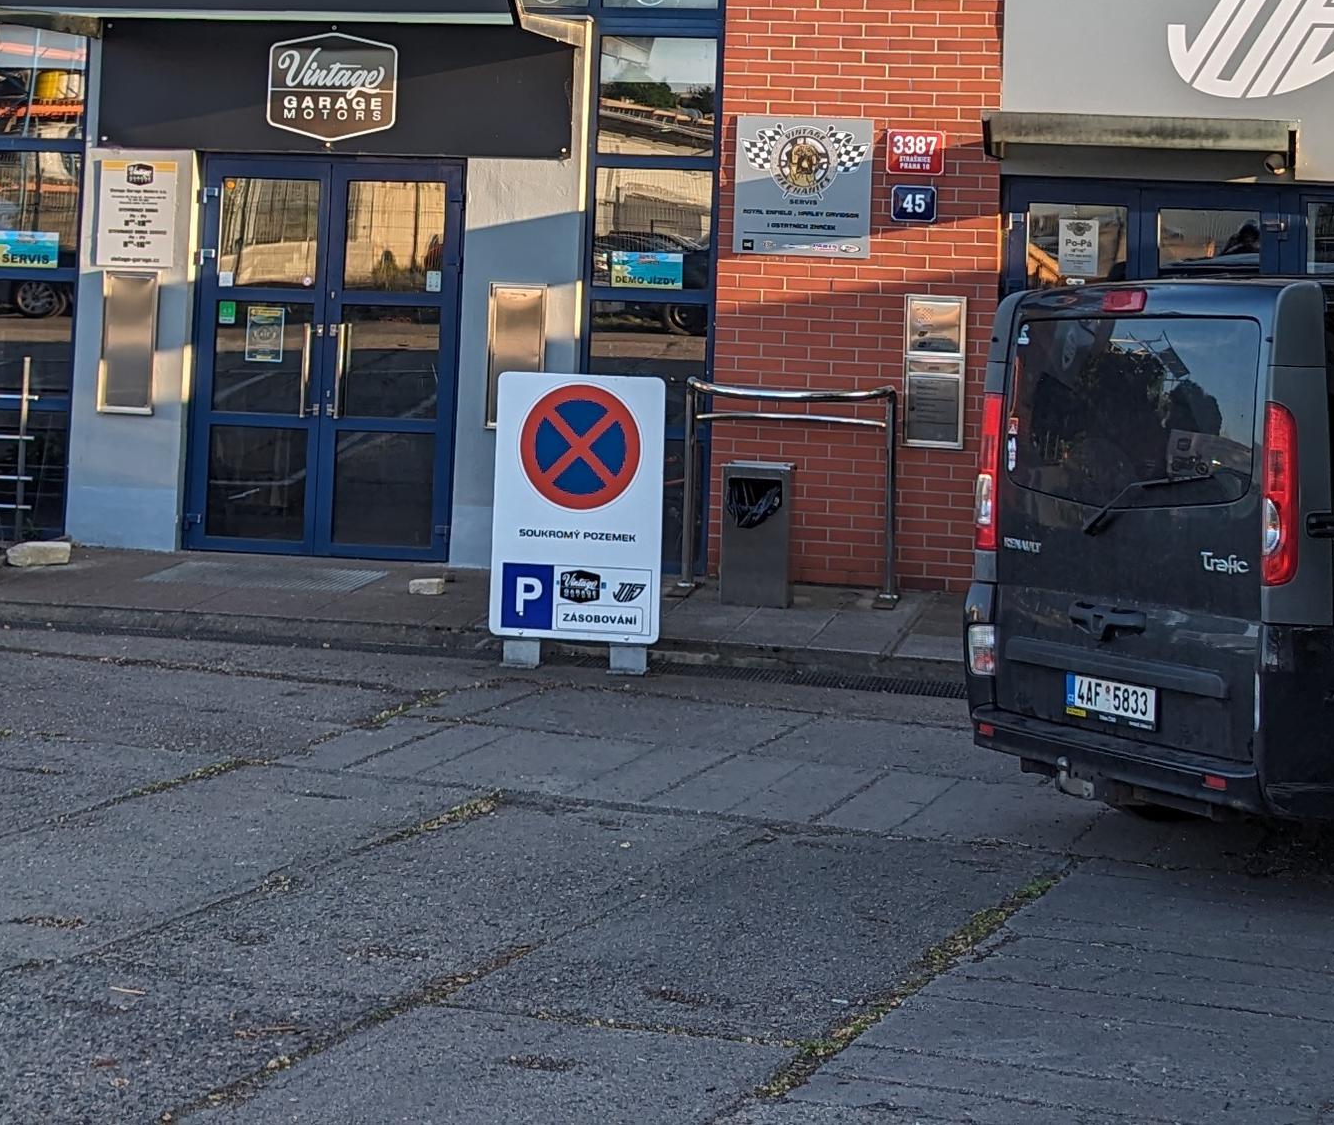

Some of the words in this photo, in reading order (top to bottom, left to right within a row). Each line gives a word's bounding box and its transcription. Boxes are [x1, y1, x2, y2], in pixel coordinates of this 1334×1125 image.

[278, 47, 385, 100] Vintage
[283, 95, 382, 110] GARAGE
[283, 108, 381, 120] MOTORS
[892, 135, 938, 155] 3387
[899, 162, 921, 170] PRAHA
[902, 194, 926, 213] 45
[2, 254, 50, 265] SERVIS
[615, 275, 645, 284] DEMO
[647, 275, 676, 285] JÍZDY
[519, 528, 581, 540] SOUKROMÝ
[583, 532, 636, 543] POZEMEK
[1200, 551, 1249, 575] Trafic
[515, 576, 543, 613] P
[562, 612, 637, 626] ZÁSOBOVÁNÍ
[1077, 679, 1102, 707] 4AF
[1113, 686, 1148, 716] 5833
